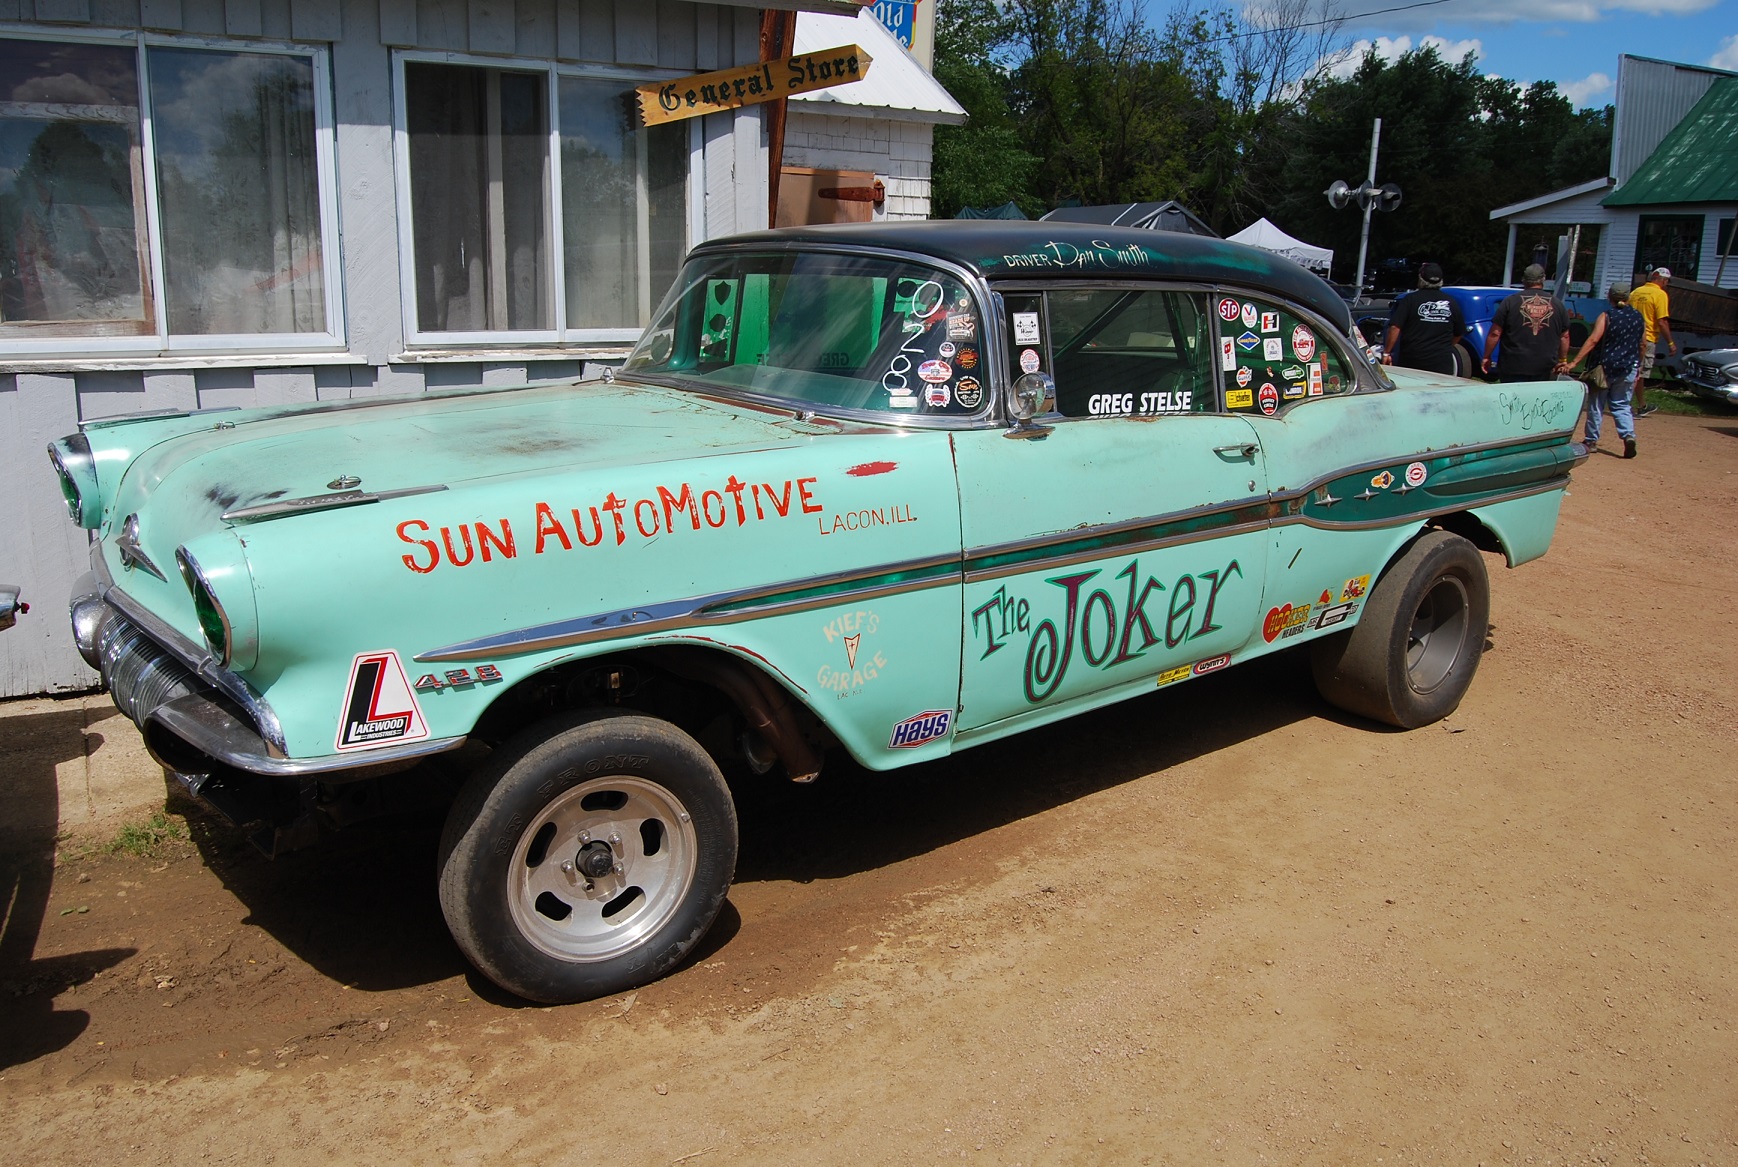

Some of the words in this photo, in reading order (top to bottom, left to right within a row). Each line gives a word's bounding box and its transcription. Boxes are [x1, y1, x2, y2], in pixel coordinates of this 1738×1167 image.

[658, 63, 775, 112] General
[788, 54, 859, 89] Store
[1003, 253, 1052, 268] DRIVER
[1220, 300, 1238, 318] STP
[1088, 392, 1133, 415] GREG
[1139, 391, 1192, 412] STELSE
[396, 518, 517, 575] SUN
[823, 610, 880, 643] KIEF'S
[971, 584, 1031, 661] The
[1023, 558, 1244, 705] Joker
[1267, 604, 1311, 634] HOOKER
[1281, 624, 1306, 640] HEADERS
[413, 664, 503, 690] 428
[817, 650, 887, 692] GARAGE
[347, 717, 405, 742] LAKEWOOD
[536, 754, 650, 800] FRONT
